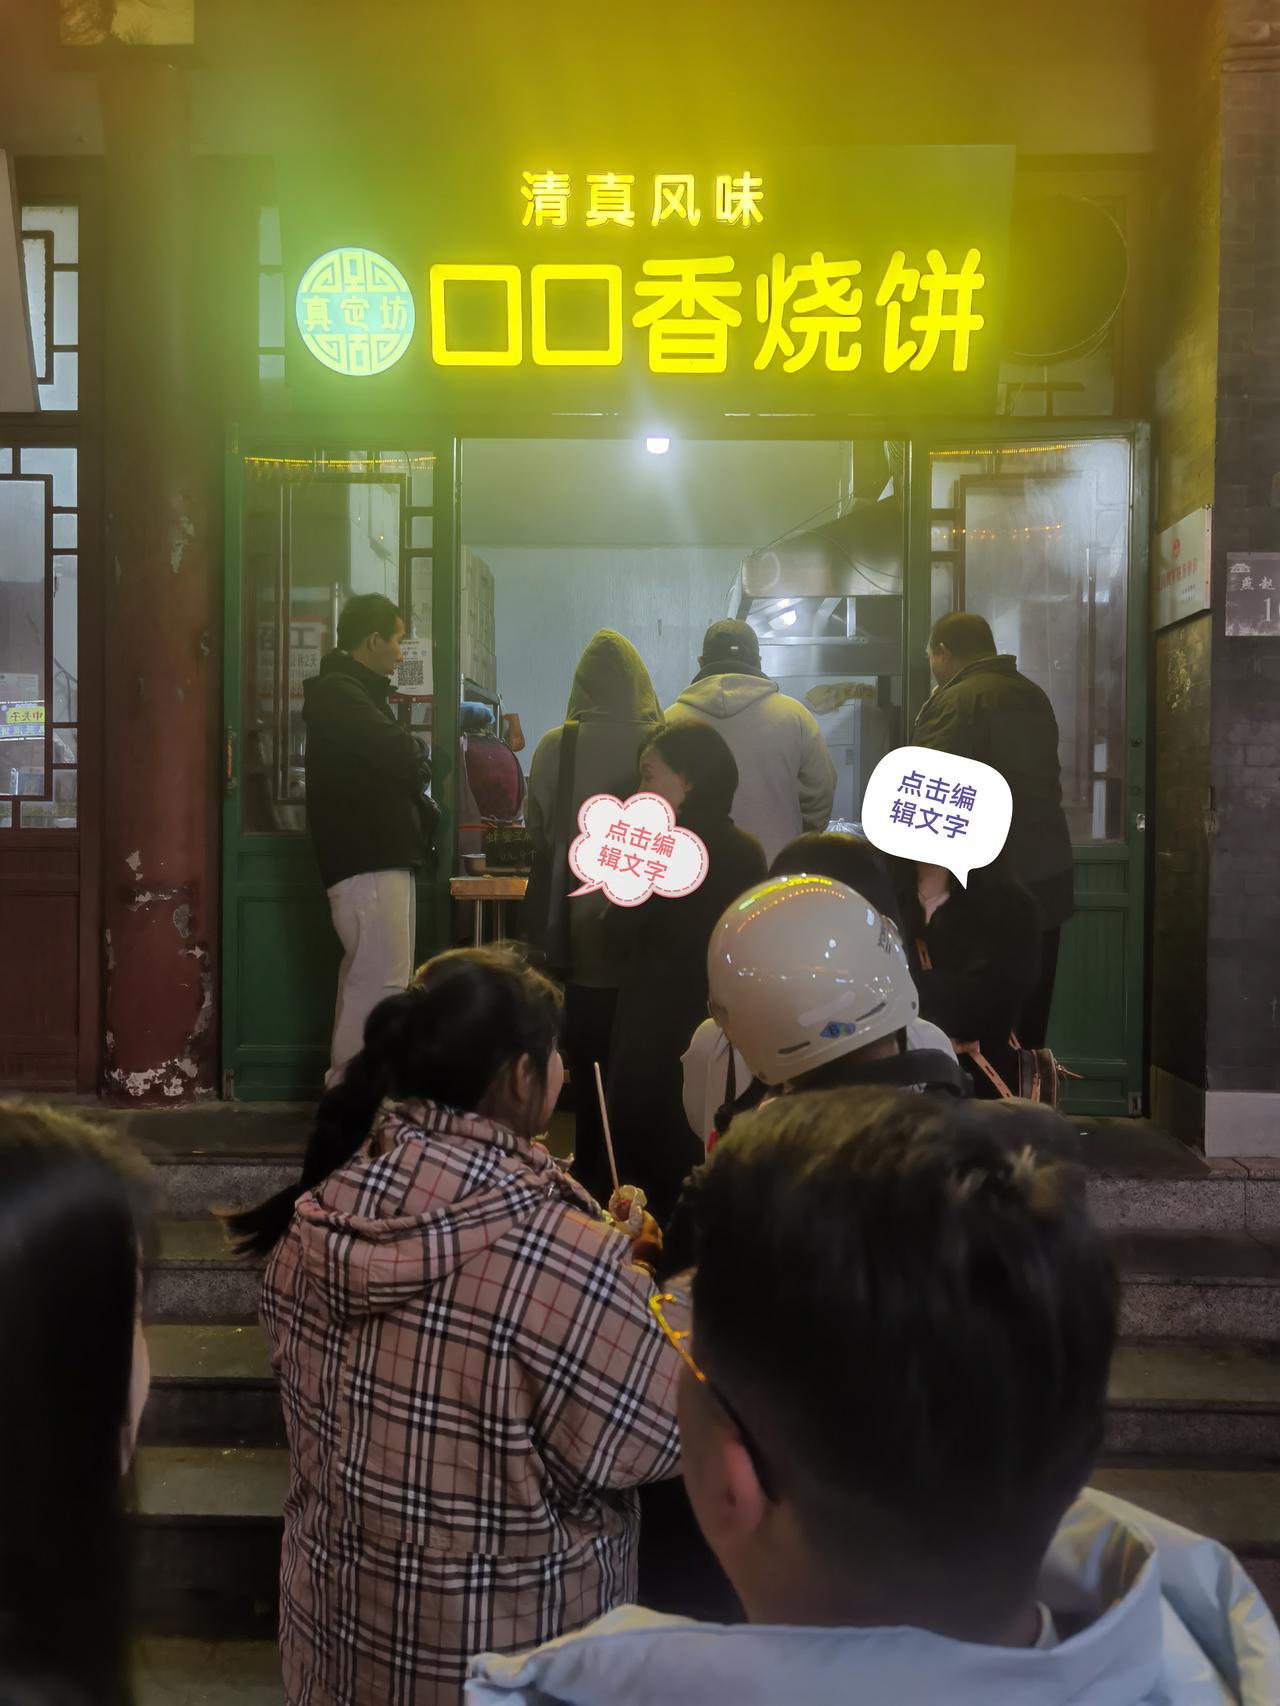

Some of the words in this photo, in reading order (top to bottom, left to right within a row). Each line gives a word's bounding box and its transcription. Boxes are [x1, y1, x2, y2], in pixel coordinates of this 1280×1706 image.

[521, 169, 765, 228] 清真风味
[303, 295, 409, 332] 真定坊
[429, 248, 986, 374] 口口香烧饼
